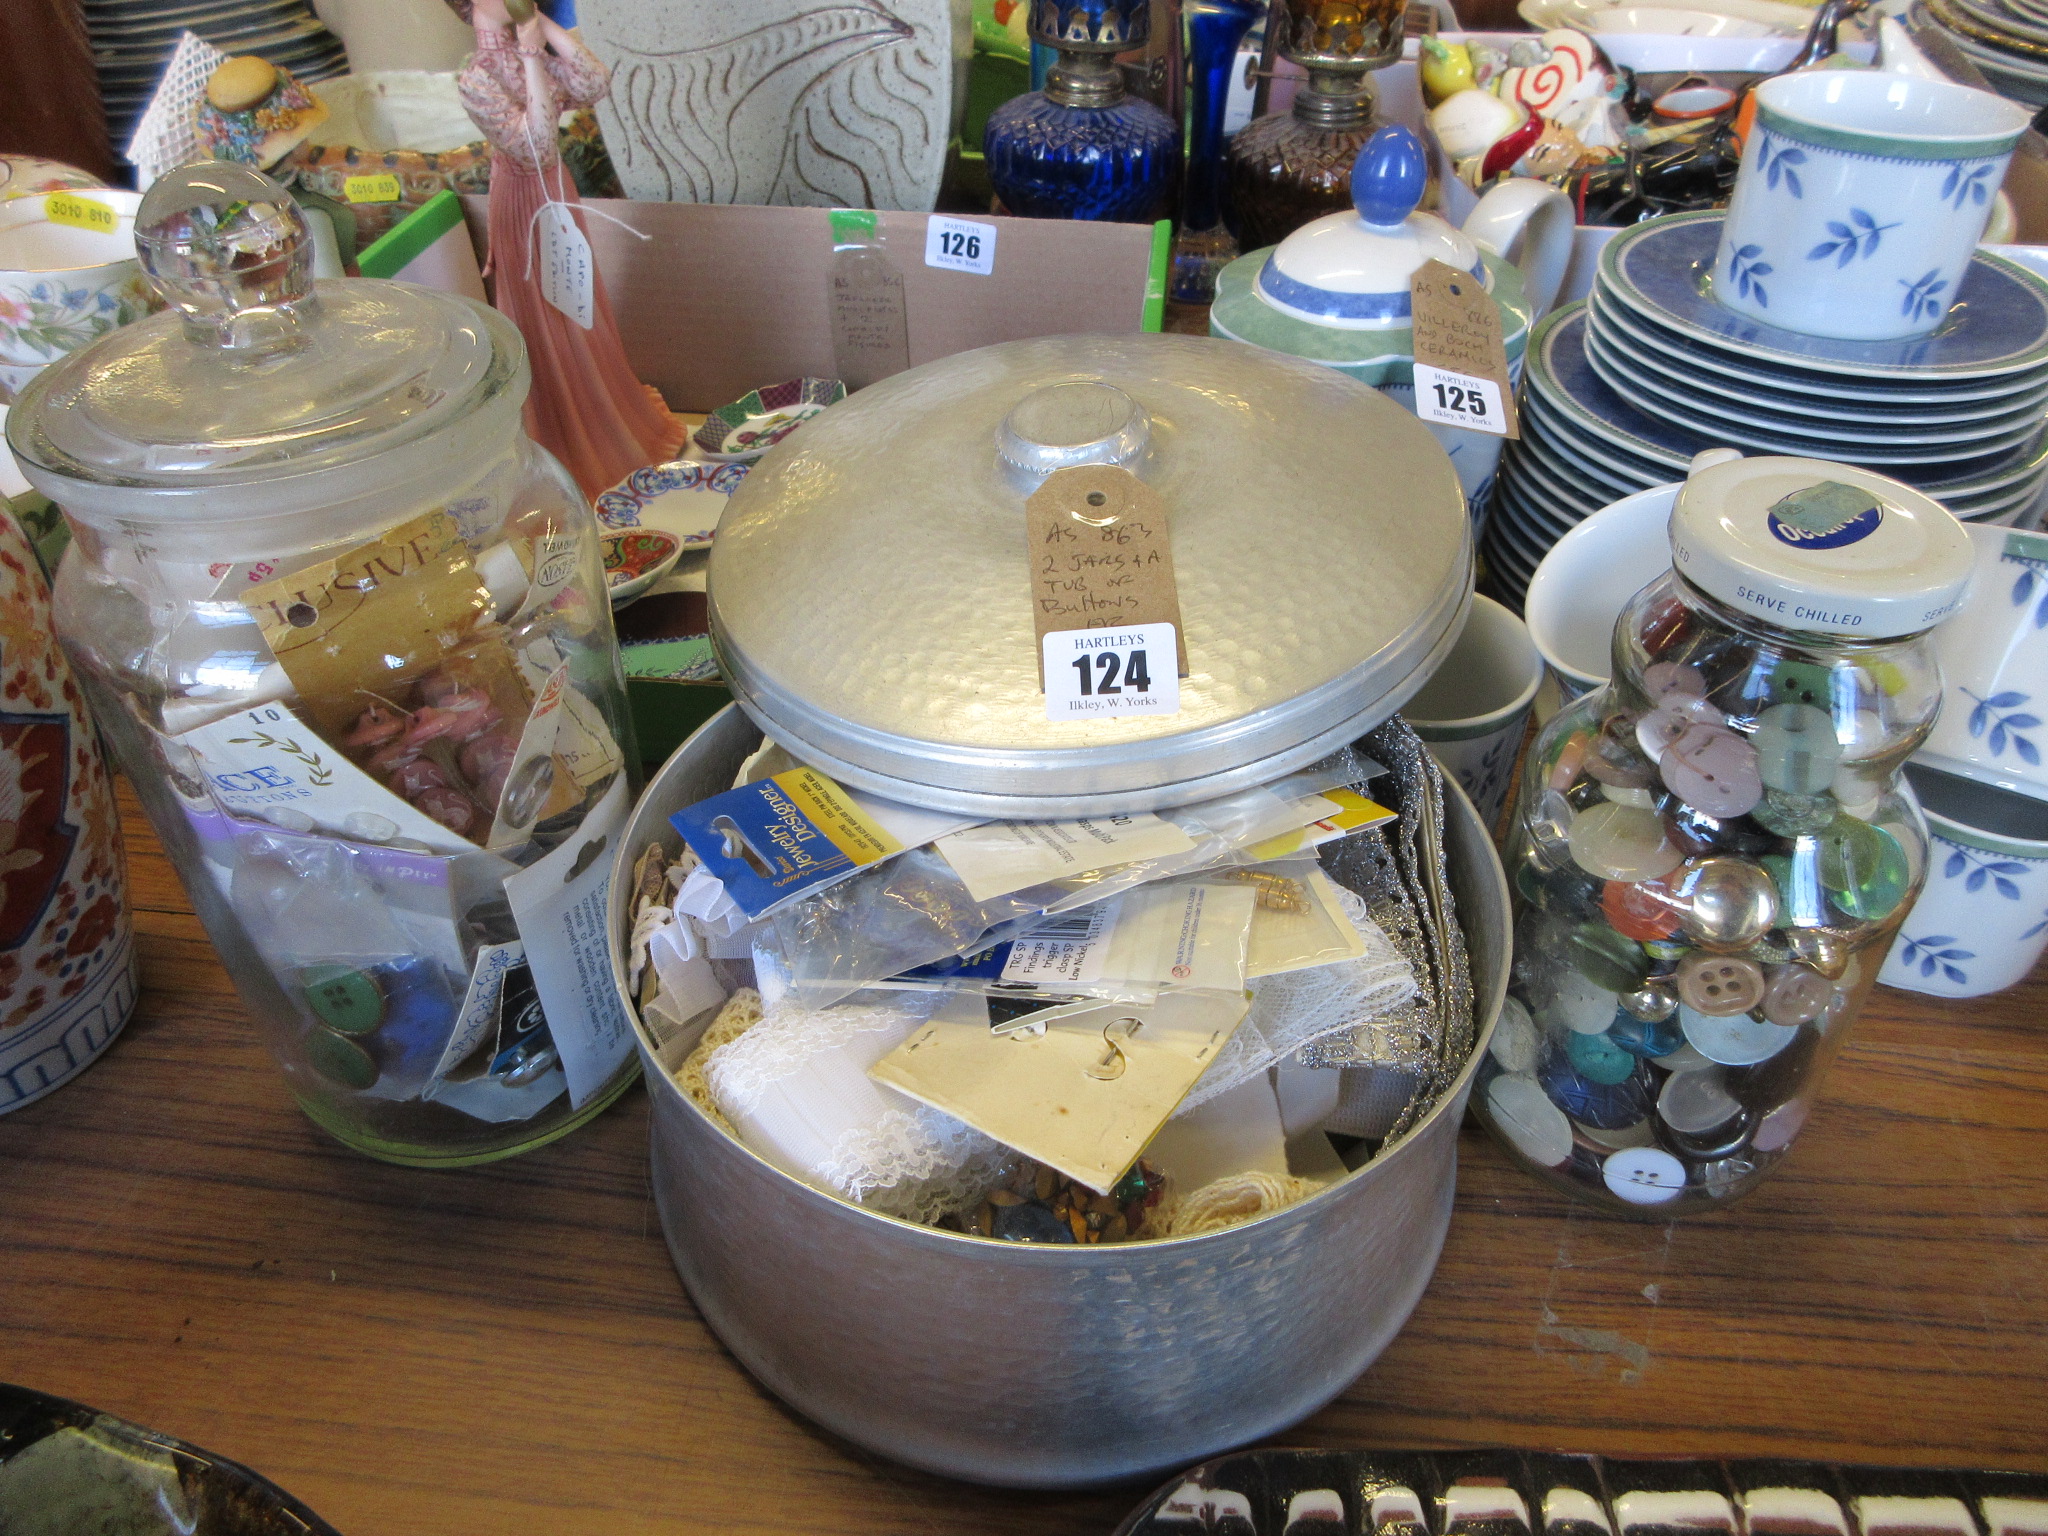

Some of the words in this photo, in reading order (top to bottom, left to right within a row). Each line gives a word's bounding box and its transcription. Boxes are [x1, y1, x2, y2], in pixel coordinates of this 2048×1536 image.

[51, 201, 82, 218] 3010
[89, 208, 112, 224] 810
[944, 222, 980, 234] HARTLEYS
[940, 231, 980, 260] 126
[1416, 282, 1432, 295] AS
[1434, 372, 1480, 389] HARTLEYS
[1432, 383, 1487, 416] 125
[1433, 408, 1458, 421] Ilkley,
[1459, 413, 1470, 422] W.
[1470, 416, 1492, 426] Yorks
[1045, 521, 1078, 544] AS
[1100, 522, 1153, 545] 863
[1042, 556, 1054, 574] 2
[1068, 553, 1126, 572] JARS
[1147, 549, 1161, 565] A
[1044, 579, 1088, 594] TUB
[1736, 586, 1787, 614] SERVE
[1794, 606, 1862, 627] CHILLED
[1074, 633, 1145, 650] HARTLEYS
[1072, 650, 1151, 696] 124
[1069, 699, 1104, 712] Ilkley,
[1107, 698, 1123, 708] W.
[1124, 696, 1158, 708] Yorks
[248, 708, 281, 725] 10
[758, 788, 817, 842] Designer
[764, 824, 820, 870] Jewelry
[563, 911, 580, 946] removed
[573, 904, 586, 928] metal
[580, 932, 588, 941] or
[585, 946, 597, 978] wooden
[573, 944, 581, 956] for
[1016, 942, 1027, 952] SP
[1063, 943, 1074, 952] SP
[1009, 954, 1024, 969] TRG
[1023, 942, 1045, 974] Findings
[1042, 942, 1059, 968] trigger
[1056, 954, 1074, 973] clasp
[576, 956, 589, 988] washing
[1068, 967, 1081, 980] Low
